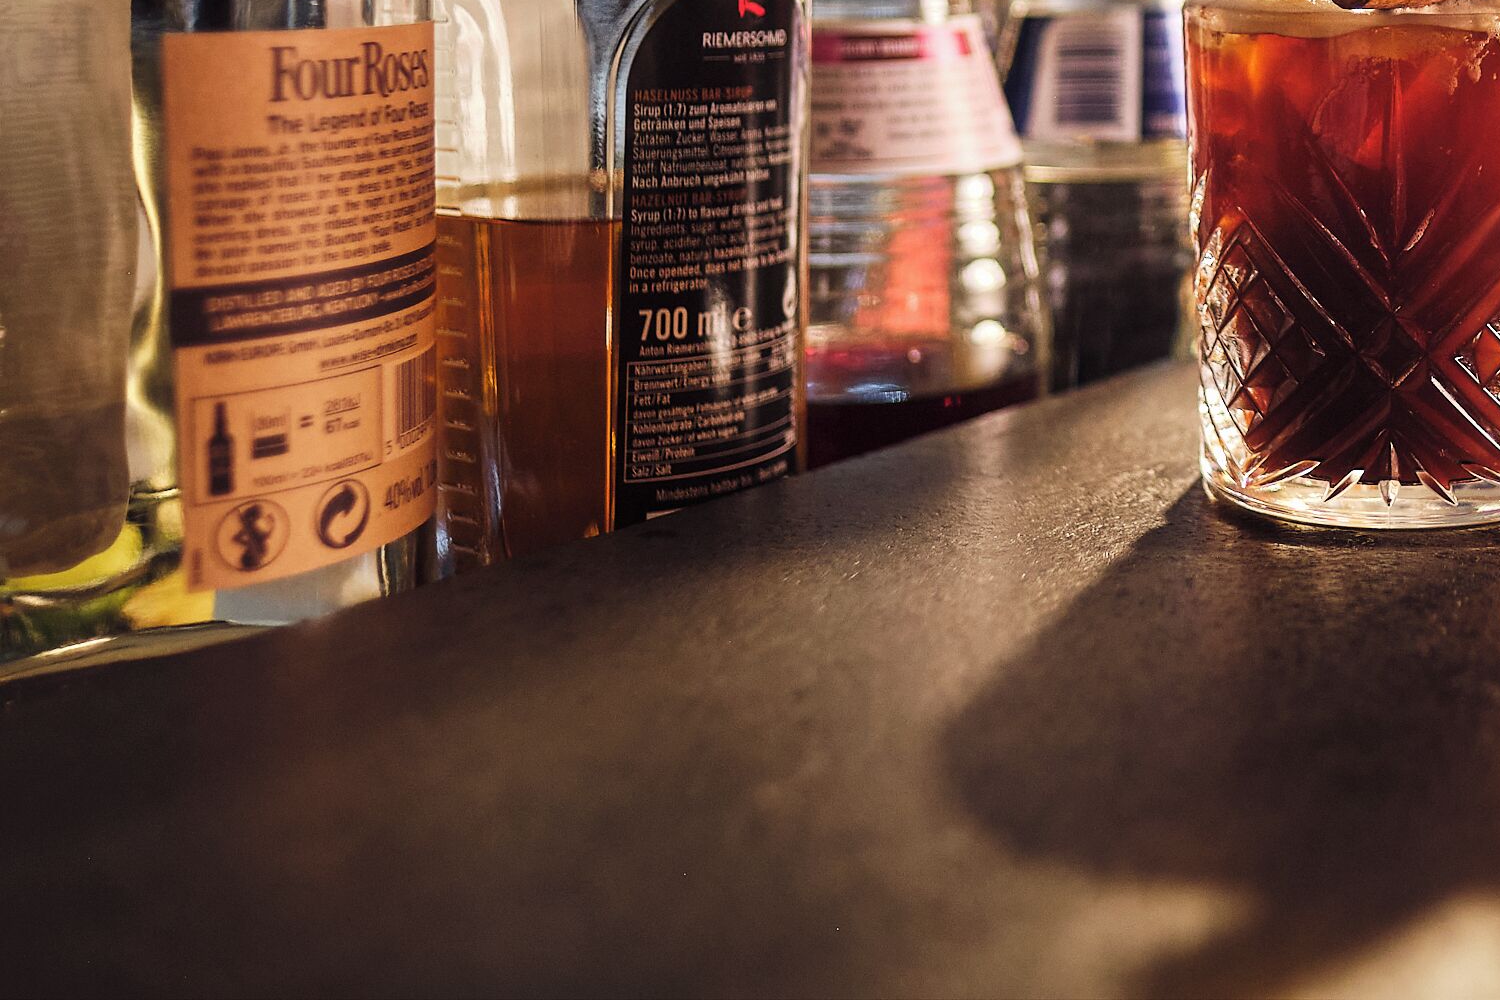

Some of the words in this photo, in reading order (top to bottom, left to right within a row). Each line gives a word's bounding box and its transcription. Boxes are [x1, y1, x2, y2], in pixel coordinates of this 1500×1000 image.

[634, 88, 698, 102] HASELNUSS
[633, 103, 661, 118] Sirup
[689, 104, 708, 116] zum
[267, 113, 302, 134] The
[310, 111, 366, 134] Legend
[688, 117, 706, 130] und
[632, 175, 658, 189] Nach
[661, 173, 701, 187] Anbruch
[631, 208, 660, 224] Syrup
[688, 207, 698, 219] to
[630, 266, 656, 280] Once
[629, 280, 639, 293] in
[638, 306, 688, 342] 700
[639, 344, 665, 357] Anton
